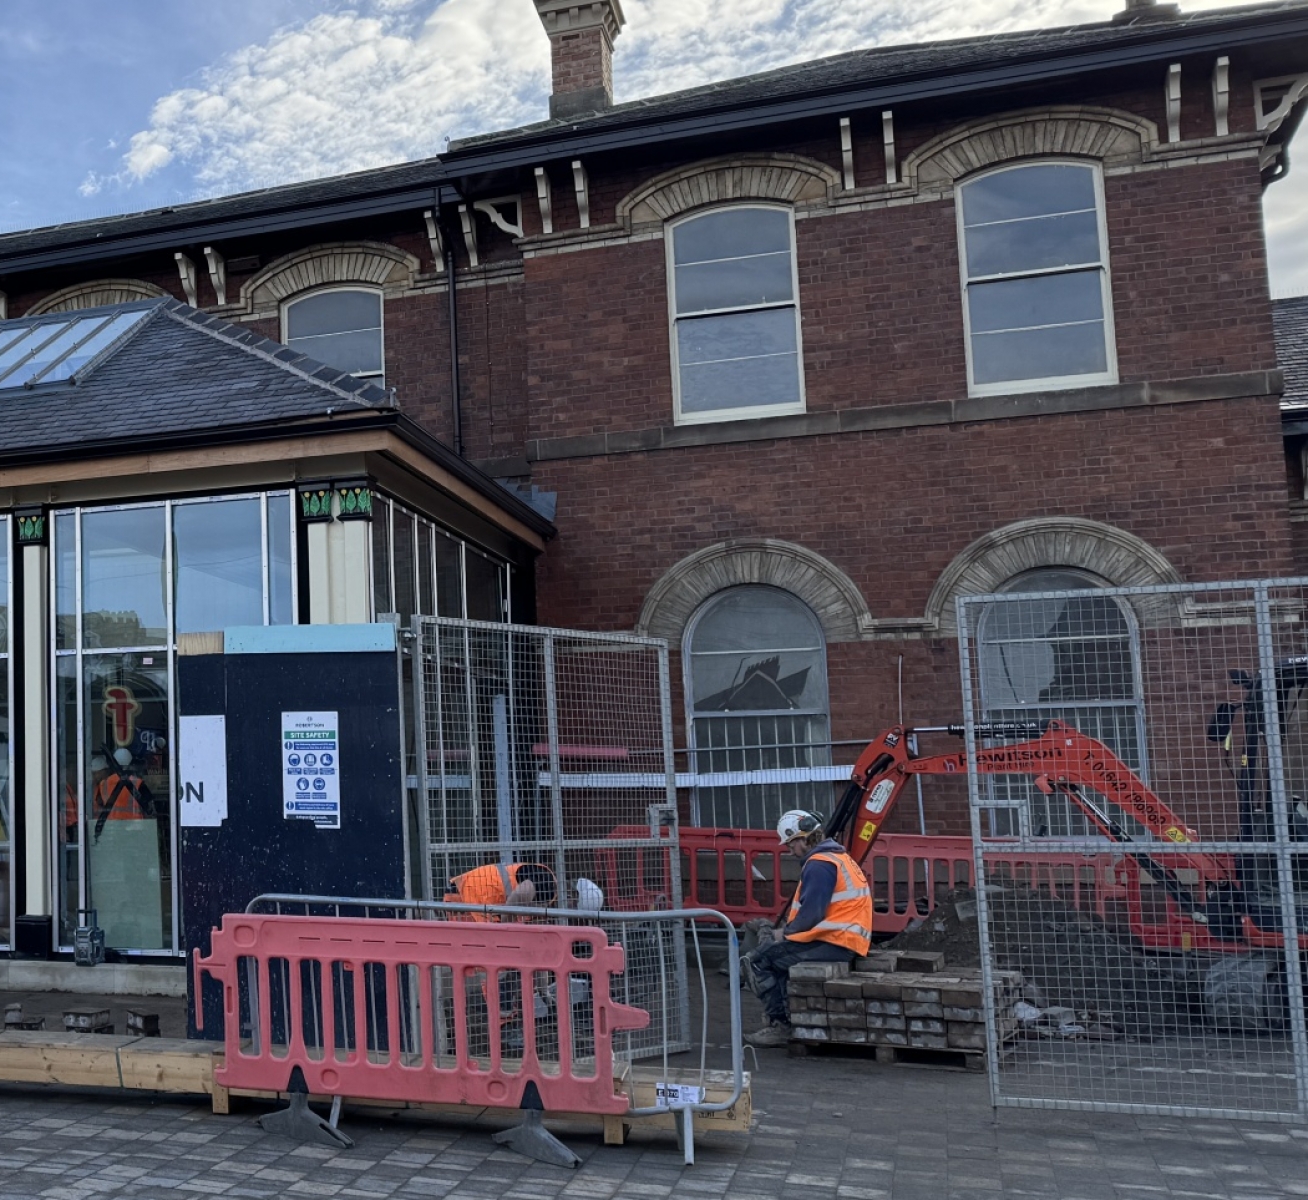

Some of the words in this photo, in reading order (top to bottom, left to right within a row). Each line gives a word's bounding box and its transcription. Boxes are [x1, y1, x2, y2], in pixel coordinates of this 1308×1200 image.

[987, 763, 1011, 771] Plant
[1014, 761, 1035, 769] Hire
[179, 781, 204, 803] N
